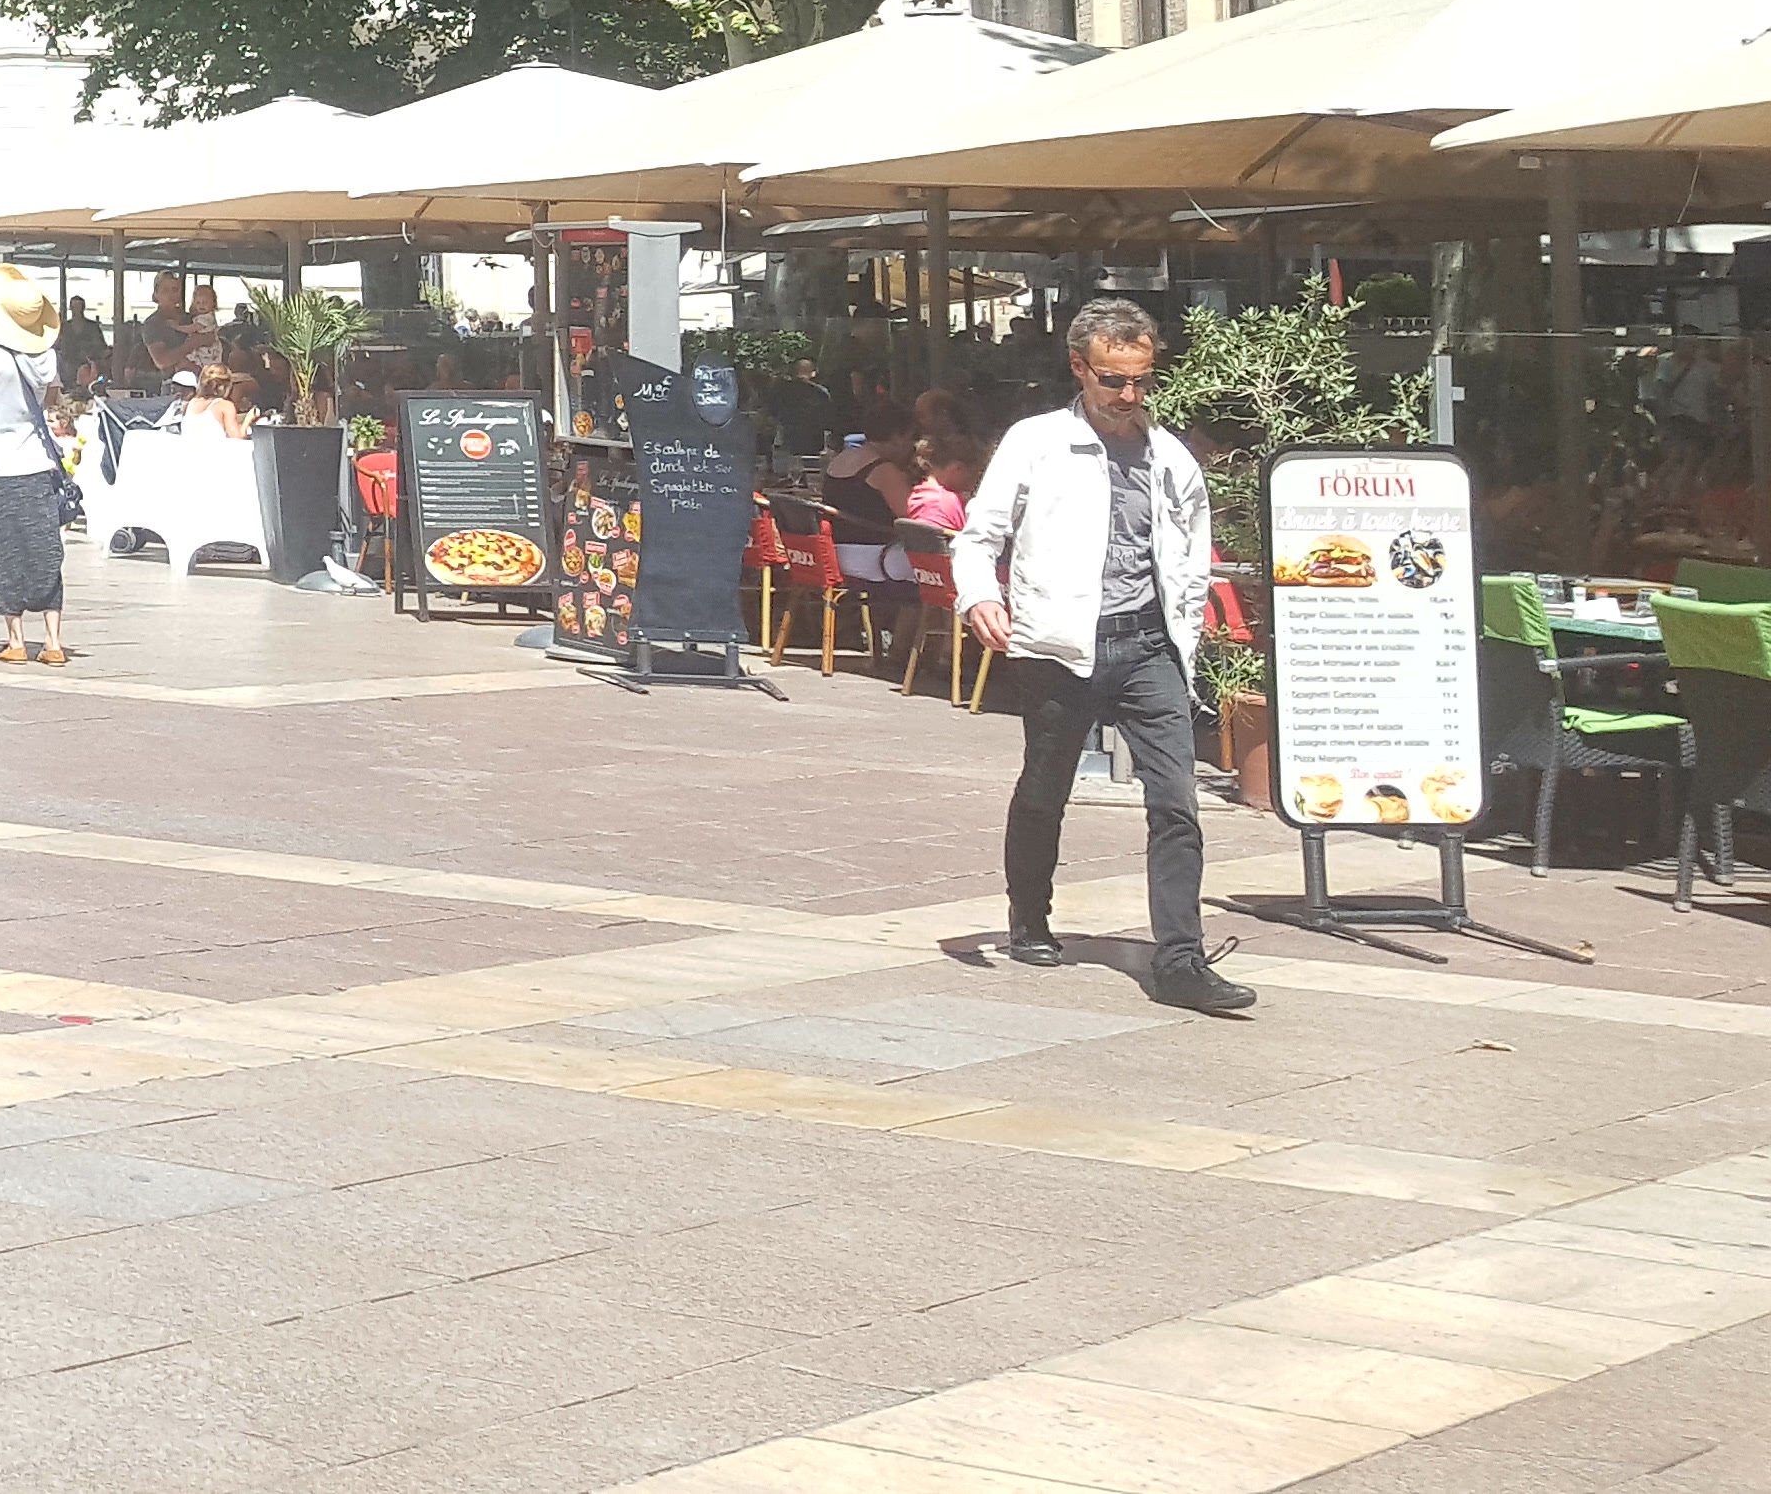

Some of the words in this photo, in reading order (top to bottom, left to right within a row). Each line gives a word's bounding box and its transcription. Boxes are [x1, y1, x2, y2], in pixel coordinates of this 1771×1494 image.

[693, 460, 711, 473] et
[1320, 477, 1415, 497] FORUM
[1279, 507, 1338, 530] Snack
[1342, 508, 1357, 530] à
[1361, 512, 1403, 530] toute
[1409, 508, 1460, 532] heure
